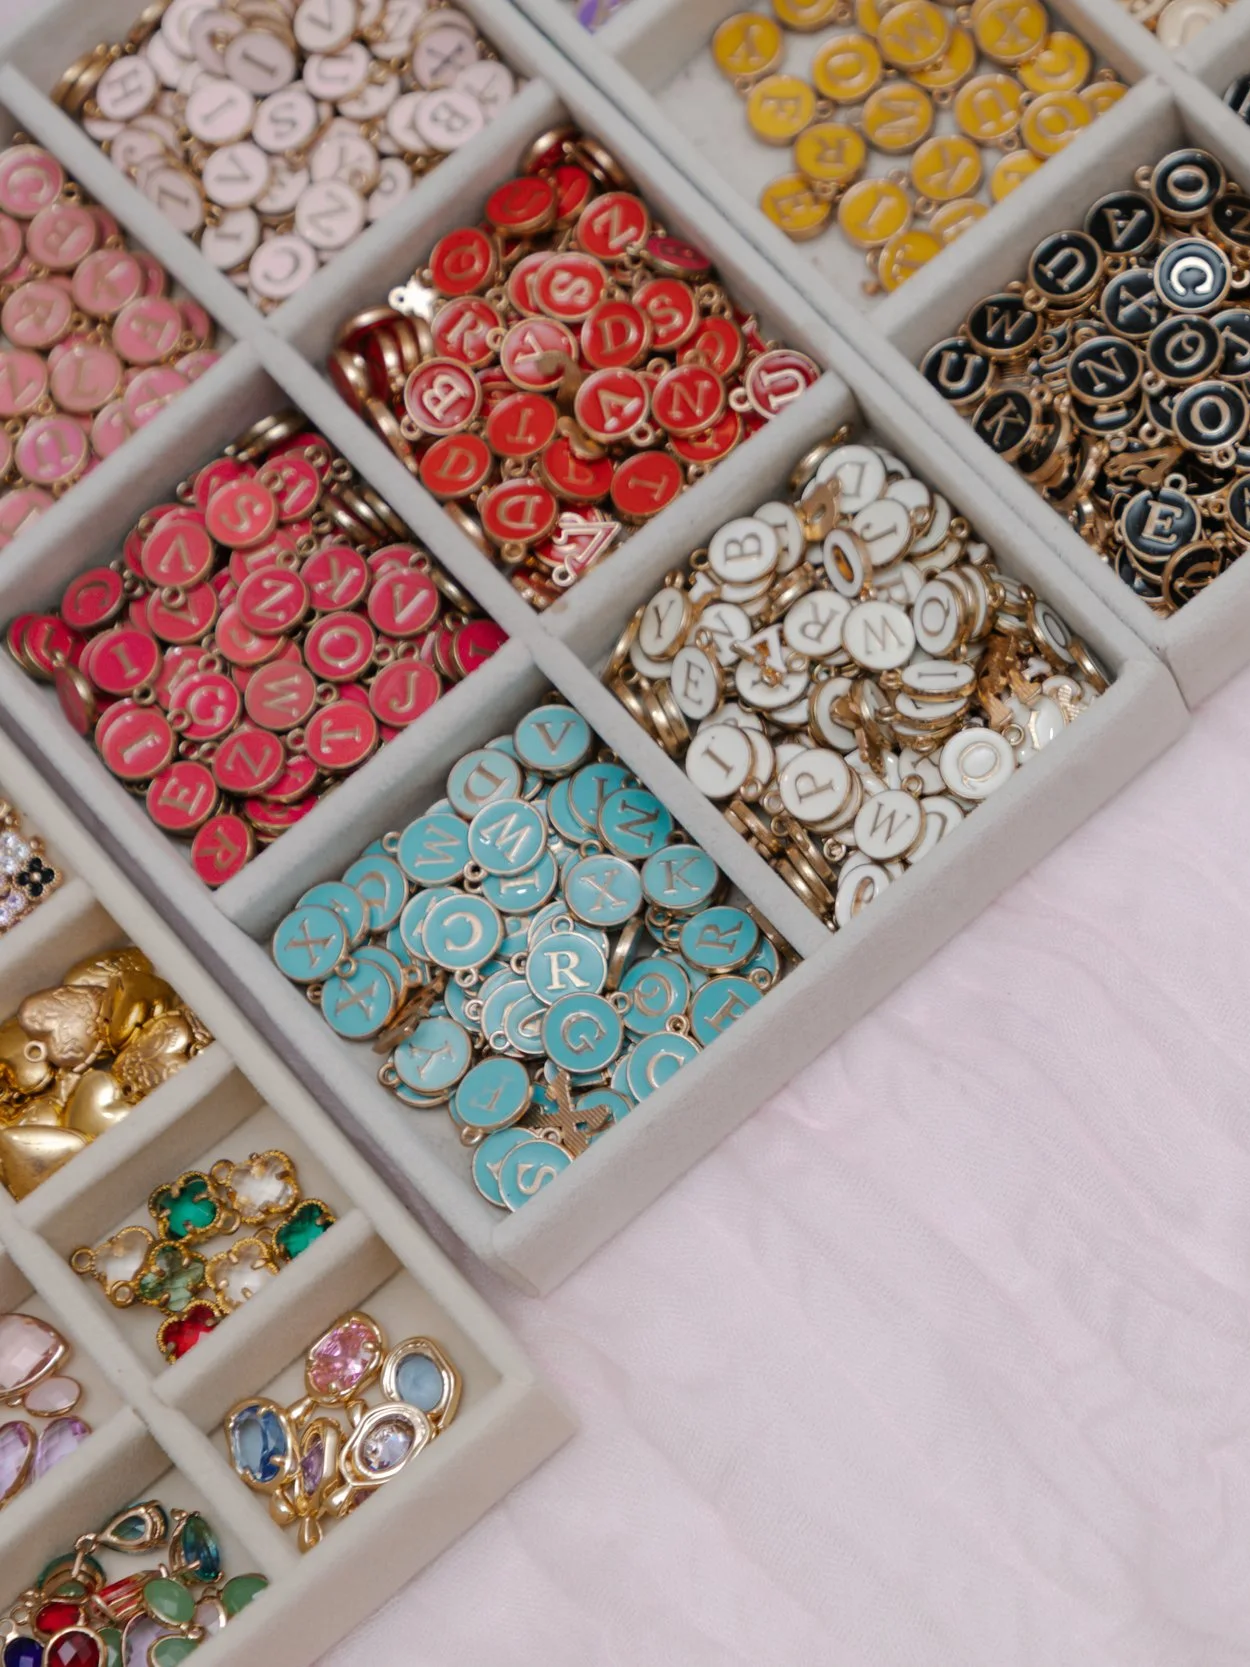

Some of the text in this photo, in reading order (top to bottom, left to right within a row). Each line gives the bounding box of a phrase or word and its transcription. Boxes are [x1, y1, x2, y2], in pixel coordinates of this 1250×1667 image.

[106, 67, 144, 109] H
[269, 101, 298, 138] S
[430, 101, 472, 132] B
[1166, 164, 1210, 206] O
[1102, 208, 1148, 247] A
[550, 268, 594, 306] S
[1038, 247, 1088, 292] U
[597, 316, 640, 354] D
[649, 294, 684, 338] S
[939, 350, 984, 393] U
[421, 373, 472, 422] B
[596, 388, 641, 430] A
[667, 379, 711, 420] N
[1190, 394, 1231, 437] O
[981, 396, 1027, 447] K
[434, 446, 478, 481] D
[218, 495, 265, 533] S
[859, 521, 899, 544] J
[1140, 500, 1184, 546] E
[723, 532, 762, 566] B
[392, 583, 432, 624] V
[652, 599, 675, 640] Y
[798, 600, 841, 645] R
[318, 627, 364, 669] O
[389, 670, 421, 713] J
[682, 659, 706, 706] E
[320, 719, 362, 754] T
[530, 720, 578, 756] V
[463, 760, 513, 806] D
[701, 746, 735, 779] I
[957, 741, 1001, 791] Q
[157, 776, 208, 817] E
[794, 770, 836, 806] P
[867, 801, 913, 843] W
[197, 826, 242, 871] R
[580, 868, 628, 913] X
[658, 856, 702, 894] K
[284, 917, 337, 969] X
[442, 911, 484, 952] C
[694, 920, 745, 956] R
[543, 950, 591, 991] R
[334, 978, 380, 1022] X
[560, 1010, 608, 1055] G
[408, 1040, 458, 1082] Y
[516, 1163, 558, 1196] S
